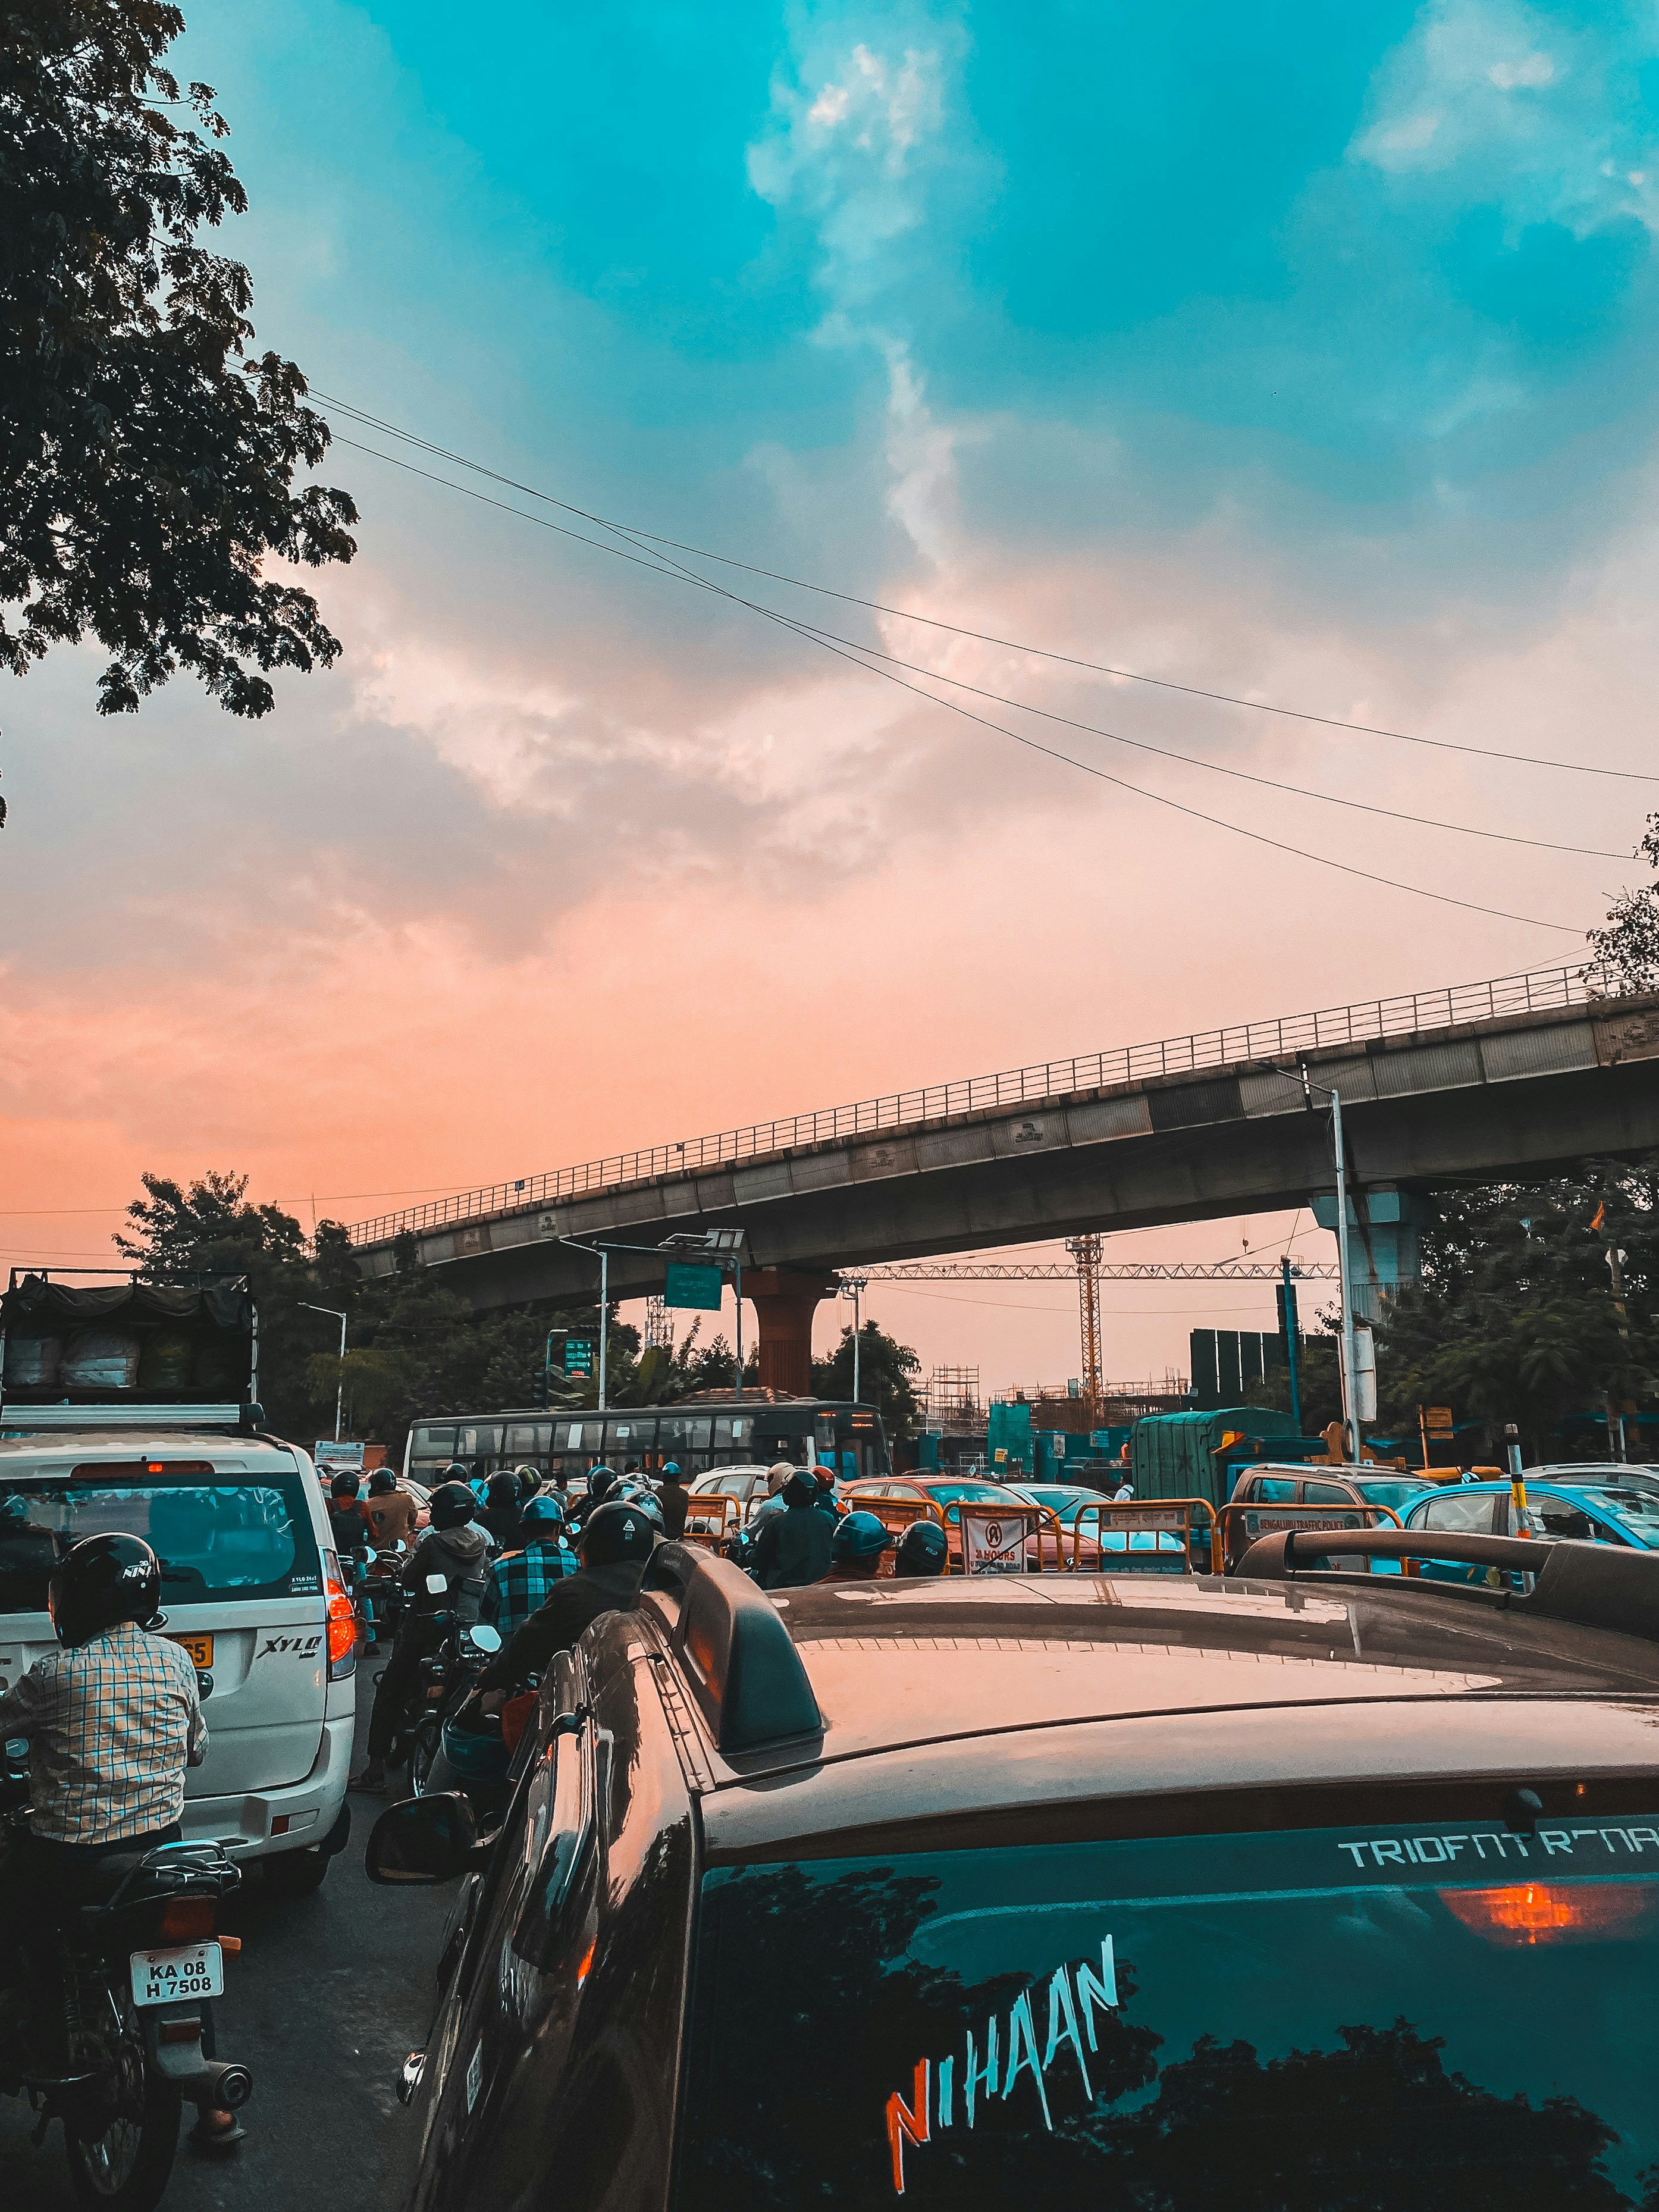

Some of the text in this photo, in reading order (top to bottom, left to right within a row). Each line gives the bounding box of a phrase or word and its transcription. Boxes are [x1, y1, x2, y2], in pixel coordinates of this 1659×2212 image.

[256, 1635, 322, 1659] XYLO
[149, 1961, 206, 1981] KA 08
[146, 1977, 212, 1998] H 7508
[885, 1933, 1119, 2195] NIHAAN
